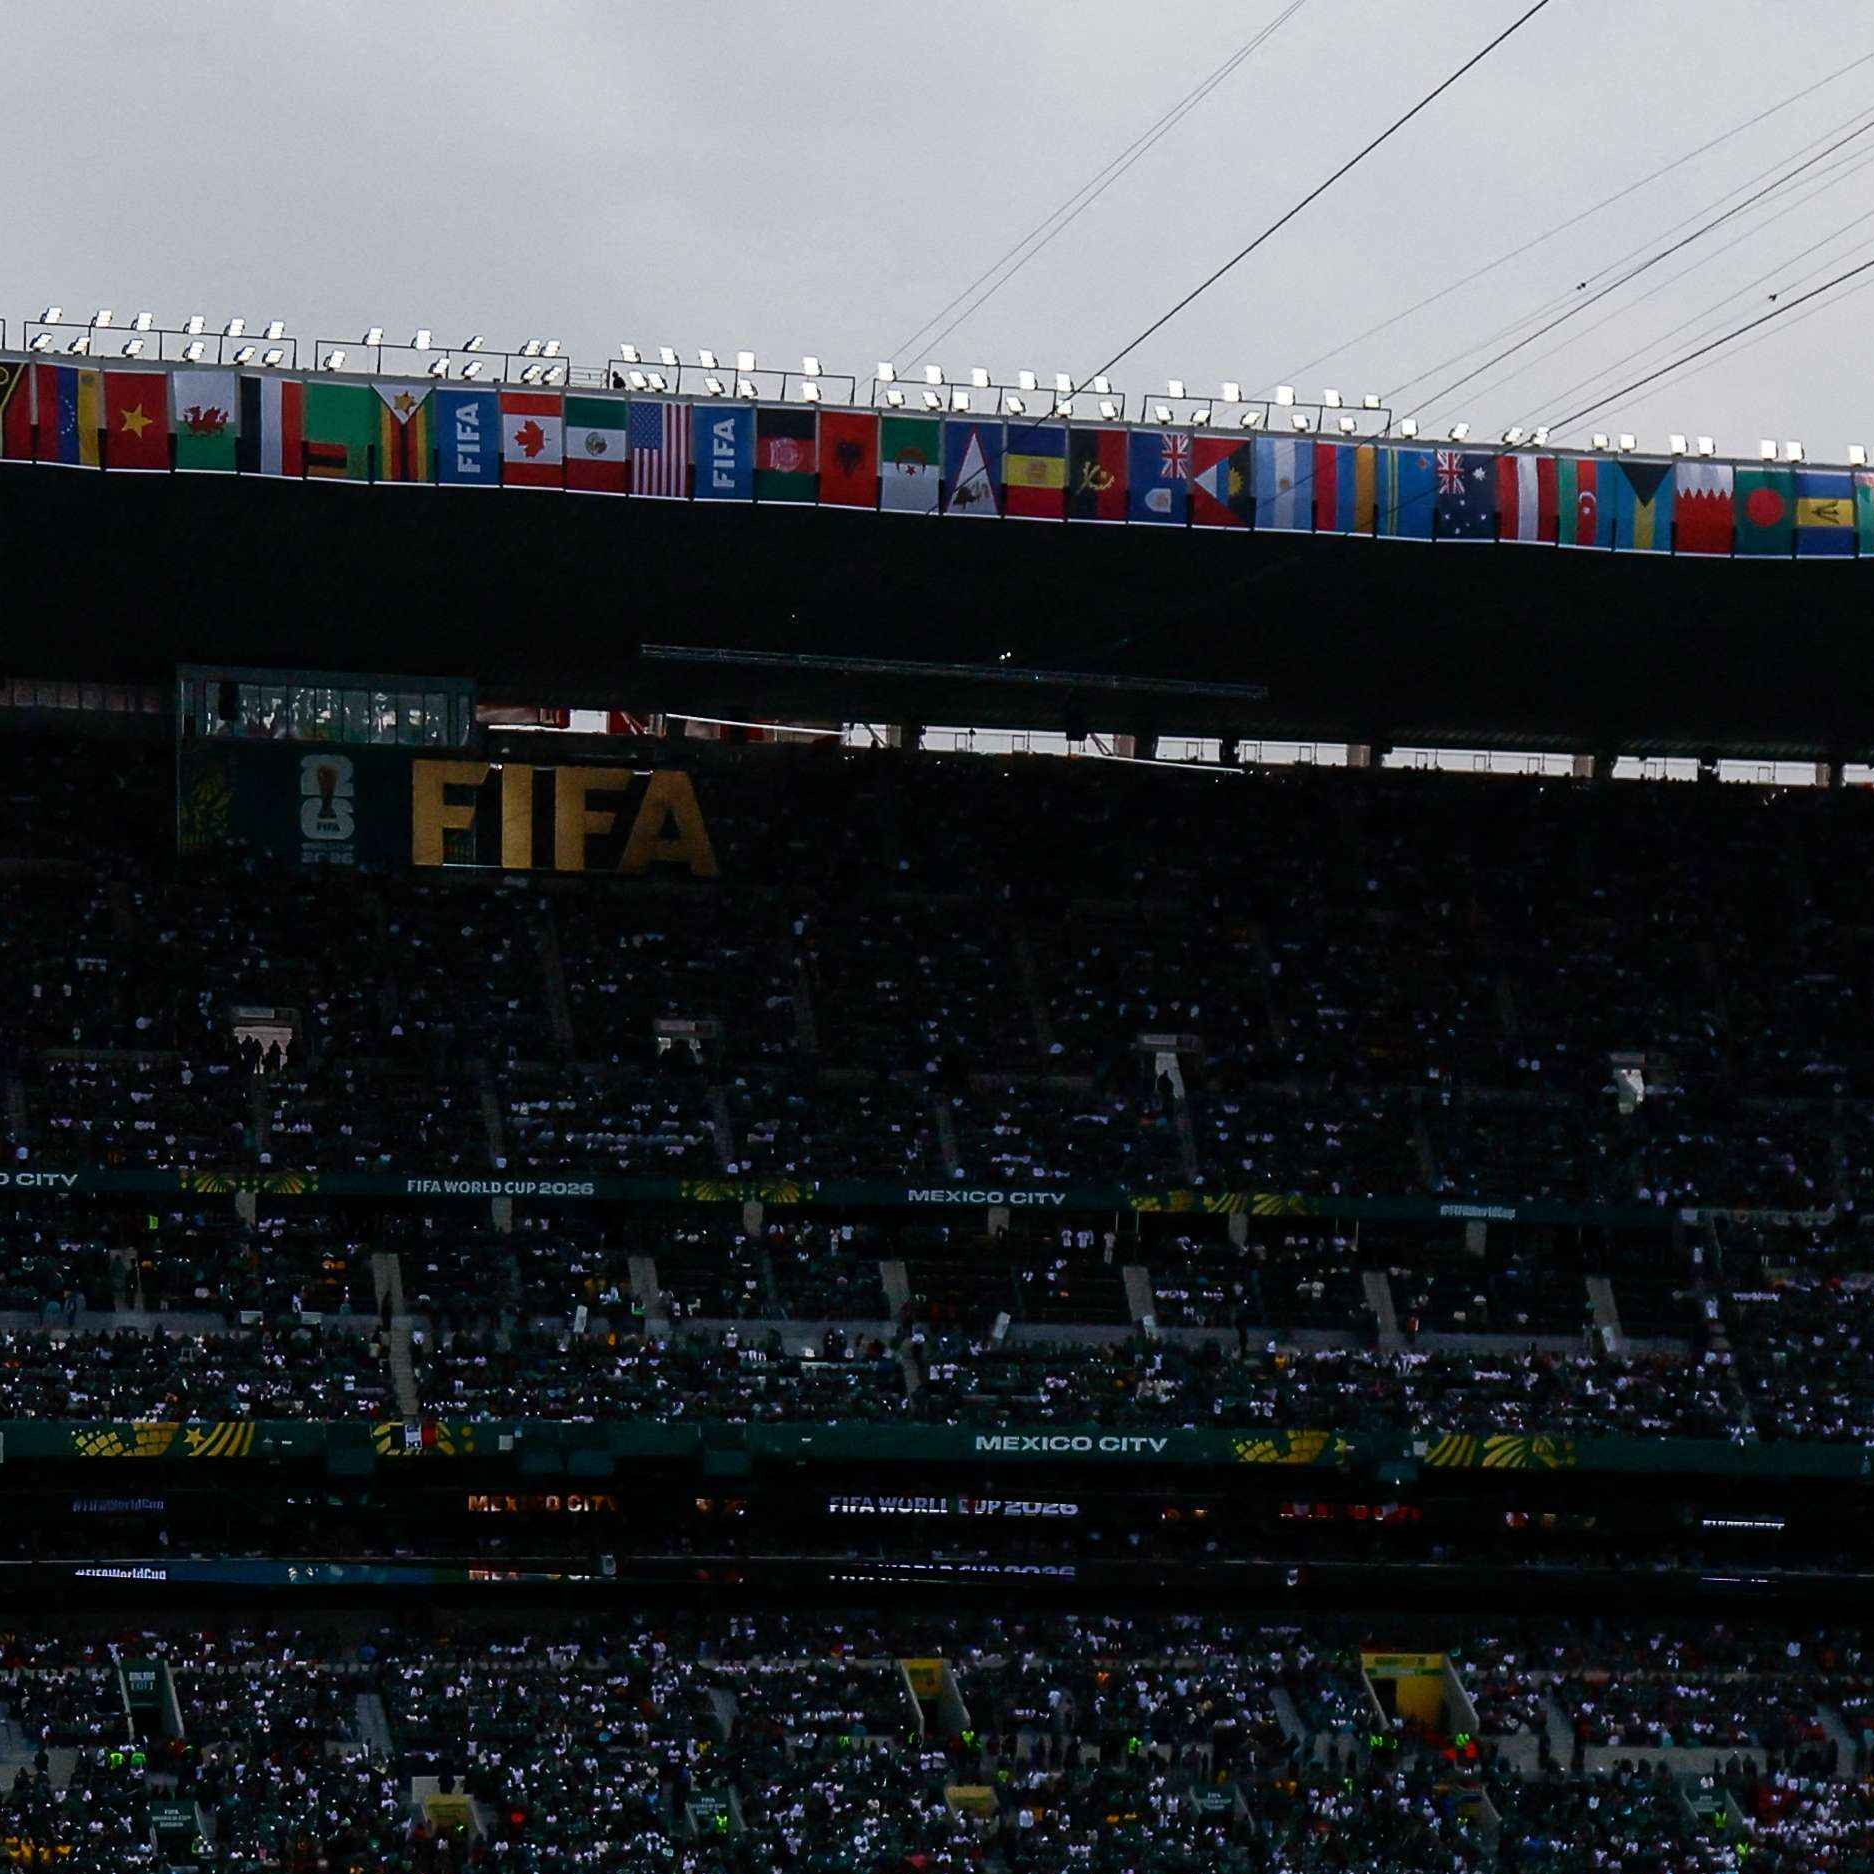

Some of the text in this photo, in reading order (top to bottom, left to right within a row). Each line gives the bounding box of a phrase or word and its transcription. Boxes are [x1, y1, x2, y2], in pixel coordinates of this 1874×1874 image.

[457, 402, 481, 474] FIFA
[711, 417, 736, 489] FIFA
[411, 758, 722, 878] FIFA
[16, 1172, 78, 1187] CITY
[407, 1179, 594, 1195] FIFA WORLD CUP 2026
[908, 1189, 1066, 1205] MEXICO CITY
[976, 1435, 1168, 1453] MEXICO CITY
